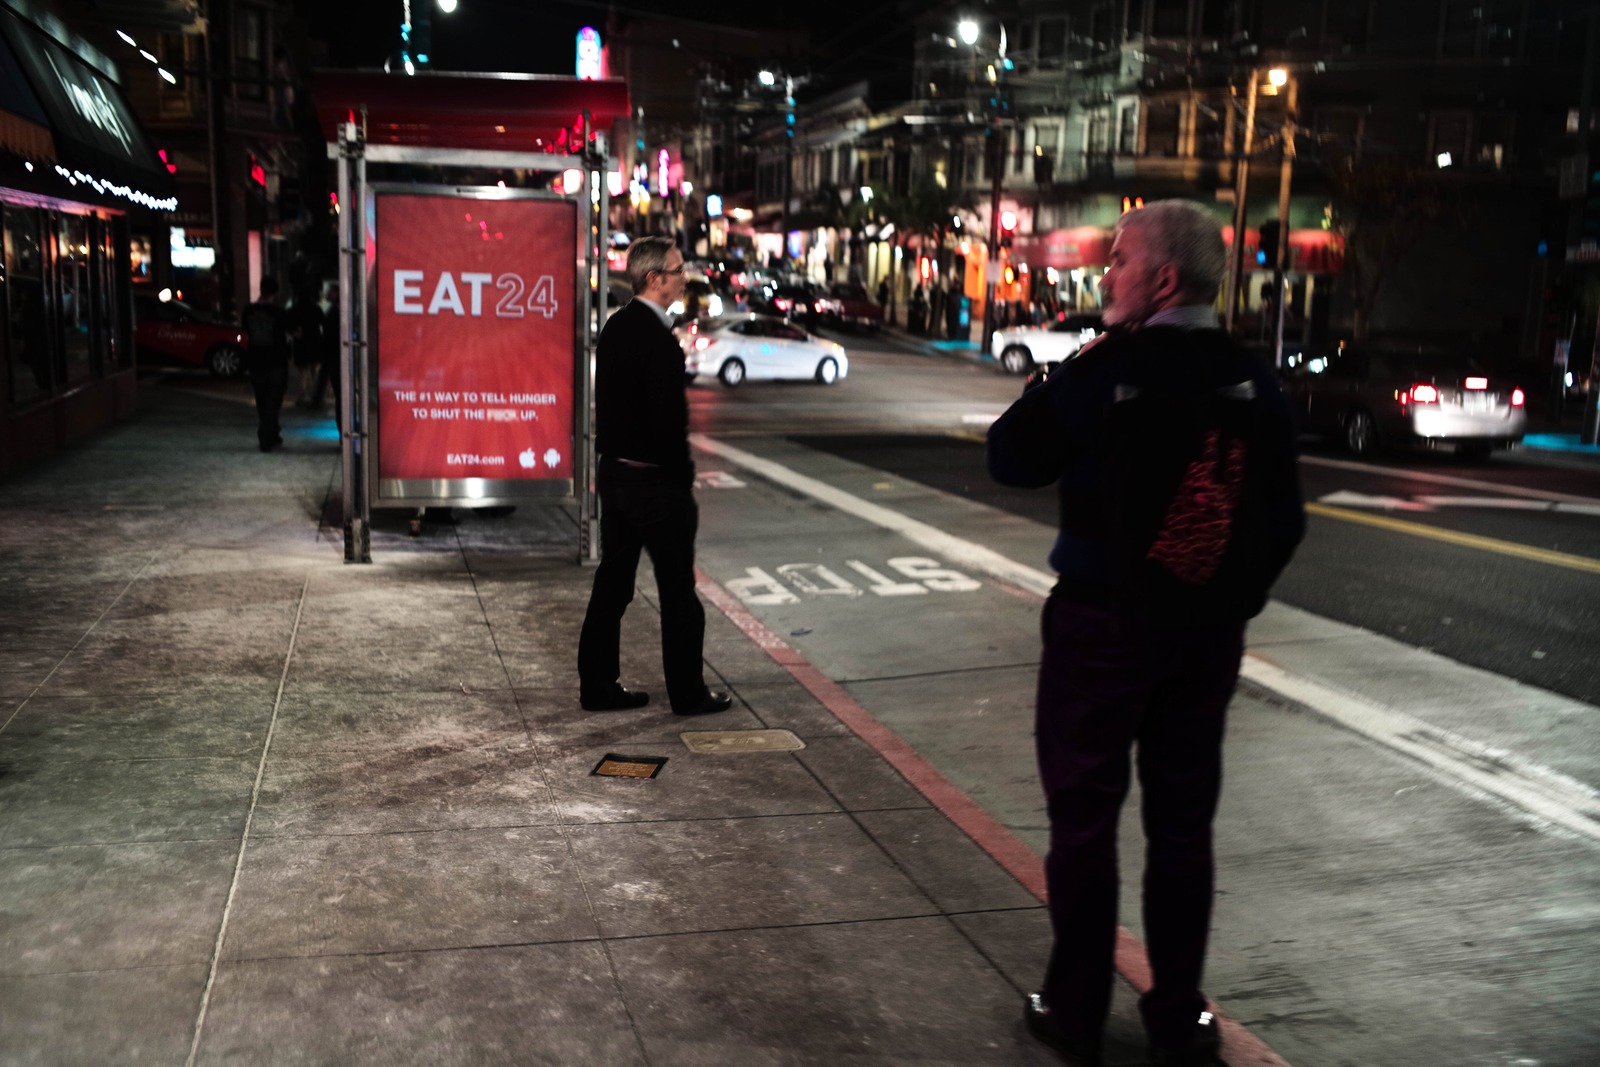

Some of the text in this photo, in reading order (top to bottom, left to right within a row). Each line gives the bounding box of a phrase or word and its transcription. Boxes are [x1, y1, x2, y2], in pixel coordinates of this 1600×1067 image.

[394, 269, 558, 319] EAT24
[394, 391, 557, 405] THE #1 WAY TO TELL HUNGER
[412, 408, 428, 420] TO
[430, 408, 461, 420] SHUT
[464, 409, 485, 421] THE
[520, 410, 539, 421] UP.
[446, 454, 505, 465] EAT24.com
[724, 556, 983, 605] STOP
